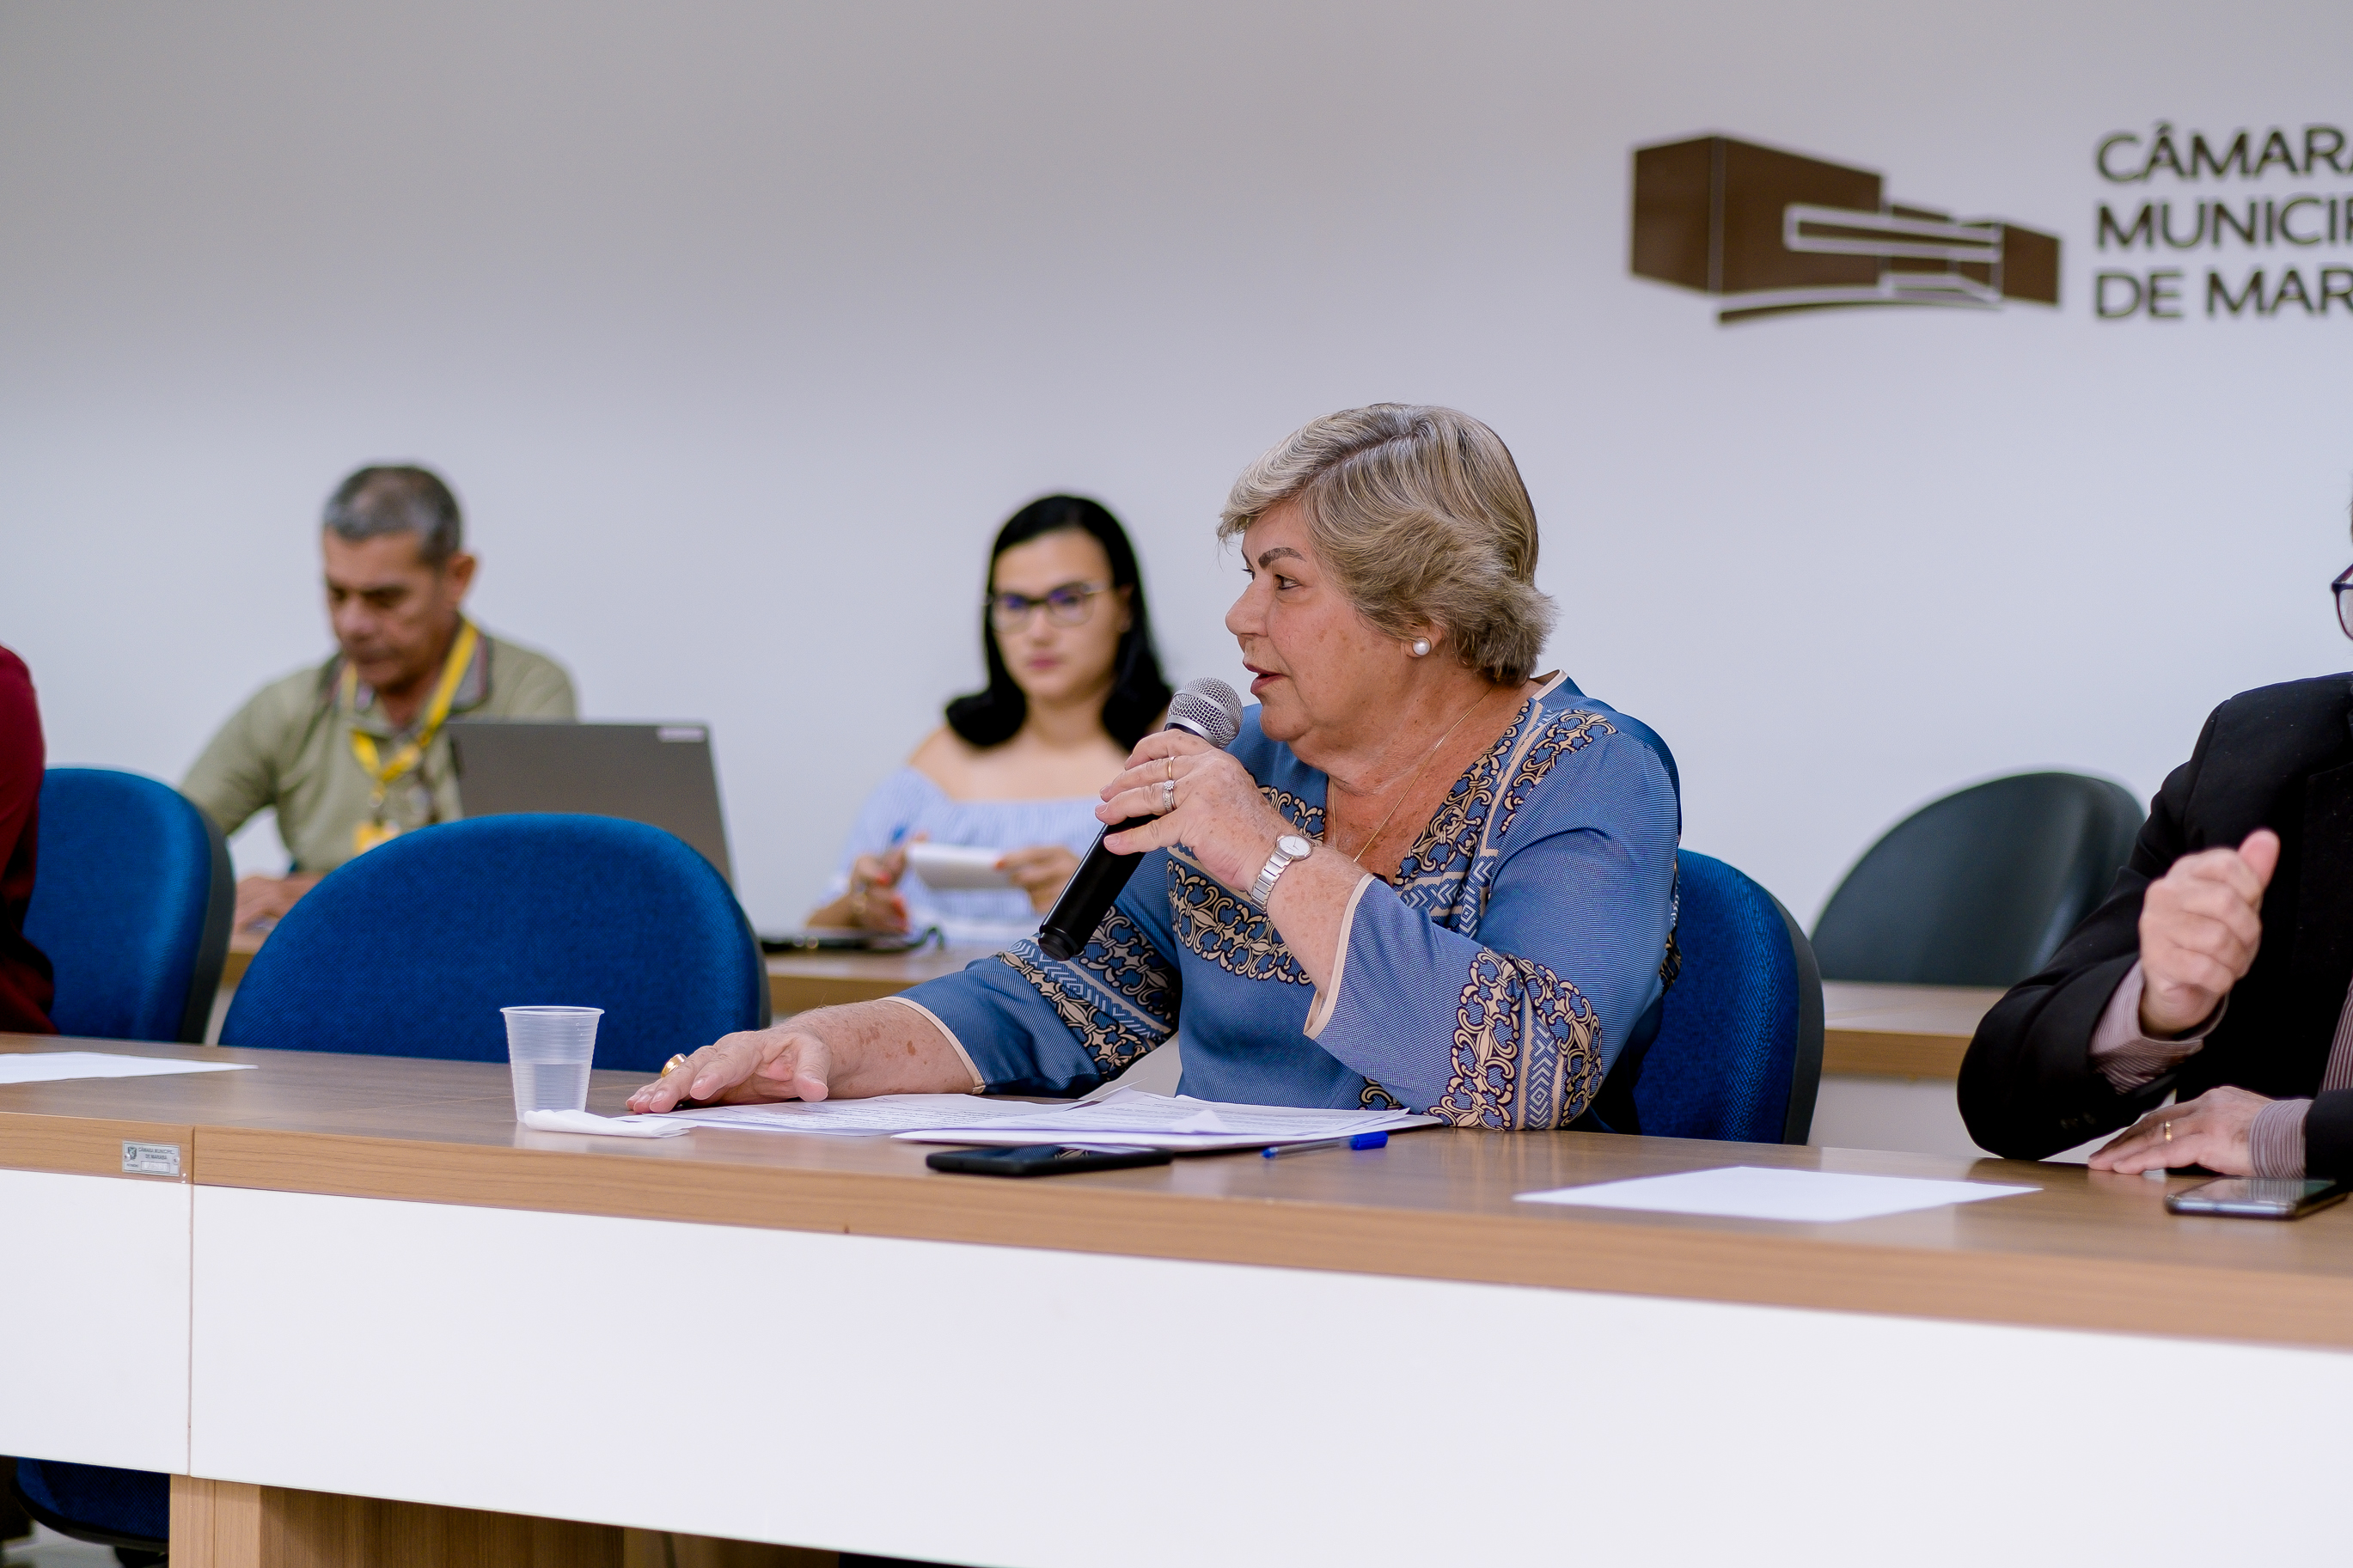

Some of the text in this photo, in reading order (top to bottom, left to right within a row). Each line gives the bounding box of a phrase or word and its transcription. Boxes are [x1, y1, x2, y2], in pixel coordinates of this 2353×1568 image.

[2097, 121, 2353, 181] CÂMAR
[2098, 196, 2353, 249] MUNICI
[2095, 268, 2353, 318] DE MAR
